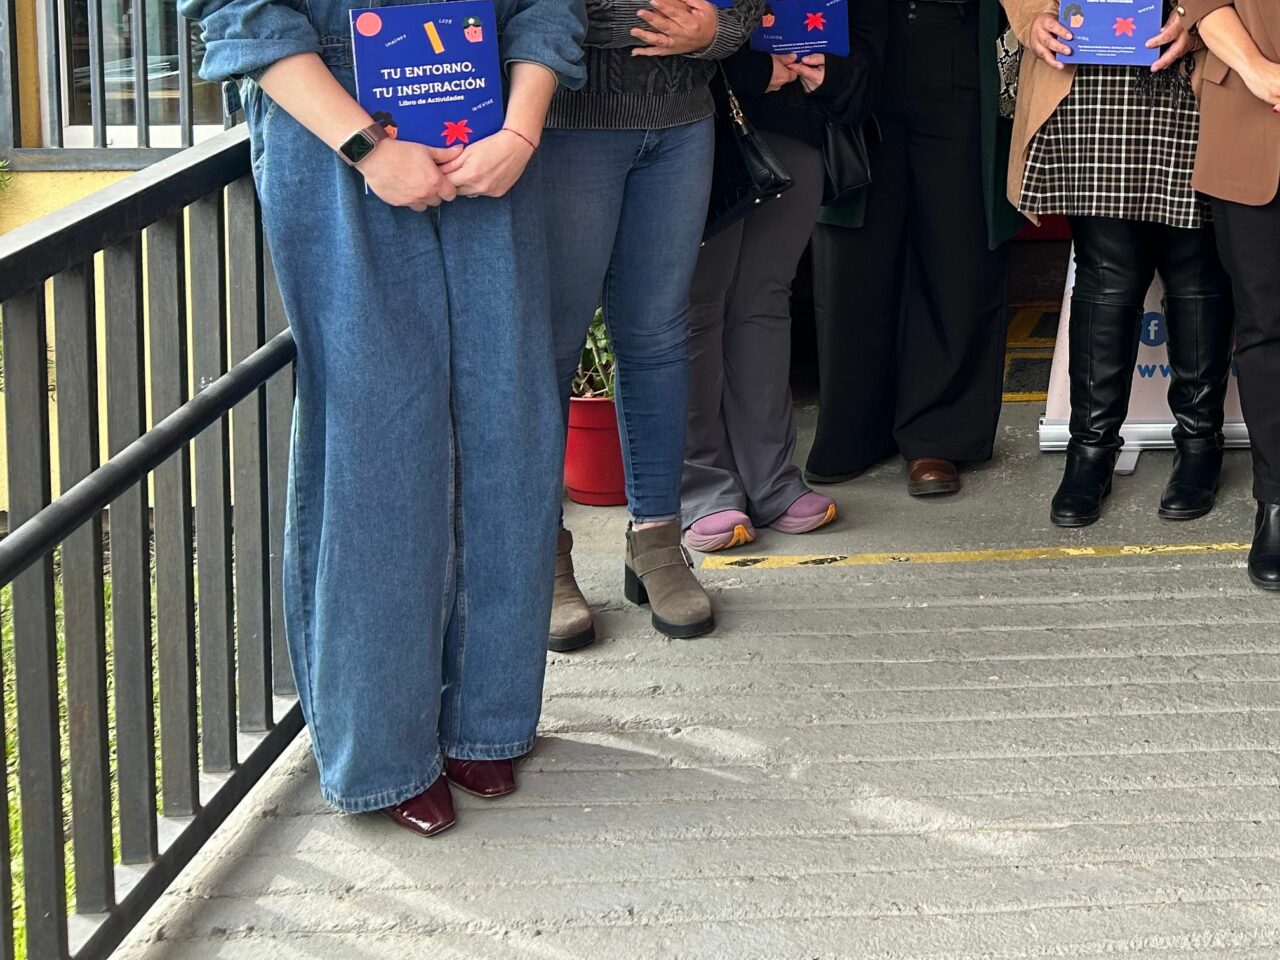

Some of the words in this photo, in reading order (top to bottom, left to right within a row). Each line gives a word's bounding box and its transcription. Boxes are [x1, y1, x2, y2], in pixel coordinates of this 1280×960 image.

[381, 68, 401, 80] TU
[405, 61, 476, 78] ENTORNO,
[373, 87, 393, 99] TU
[397, 77, 486, 97] INSPIRACIÓN
[398, 99, 416, 107] Libro
[427, 94, 465, 104] Actividades
